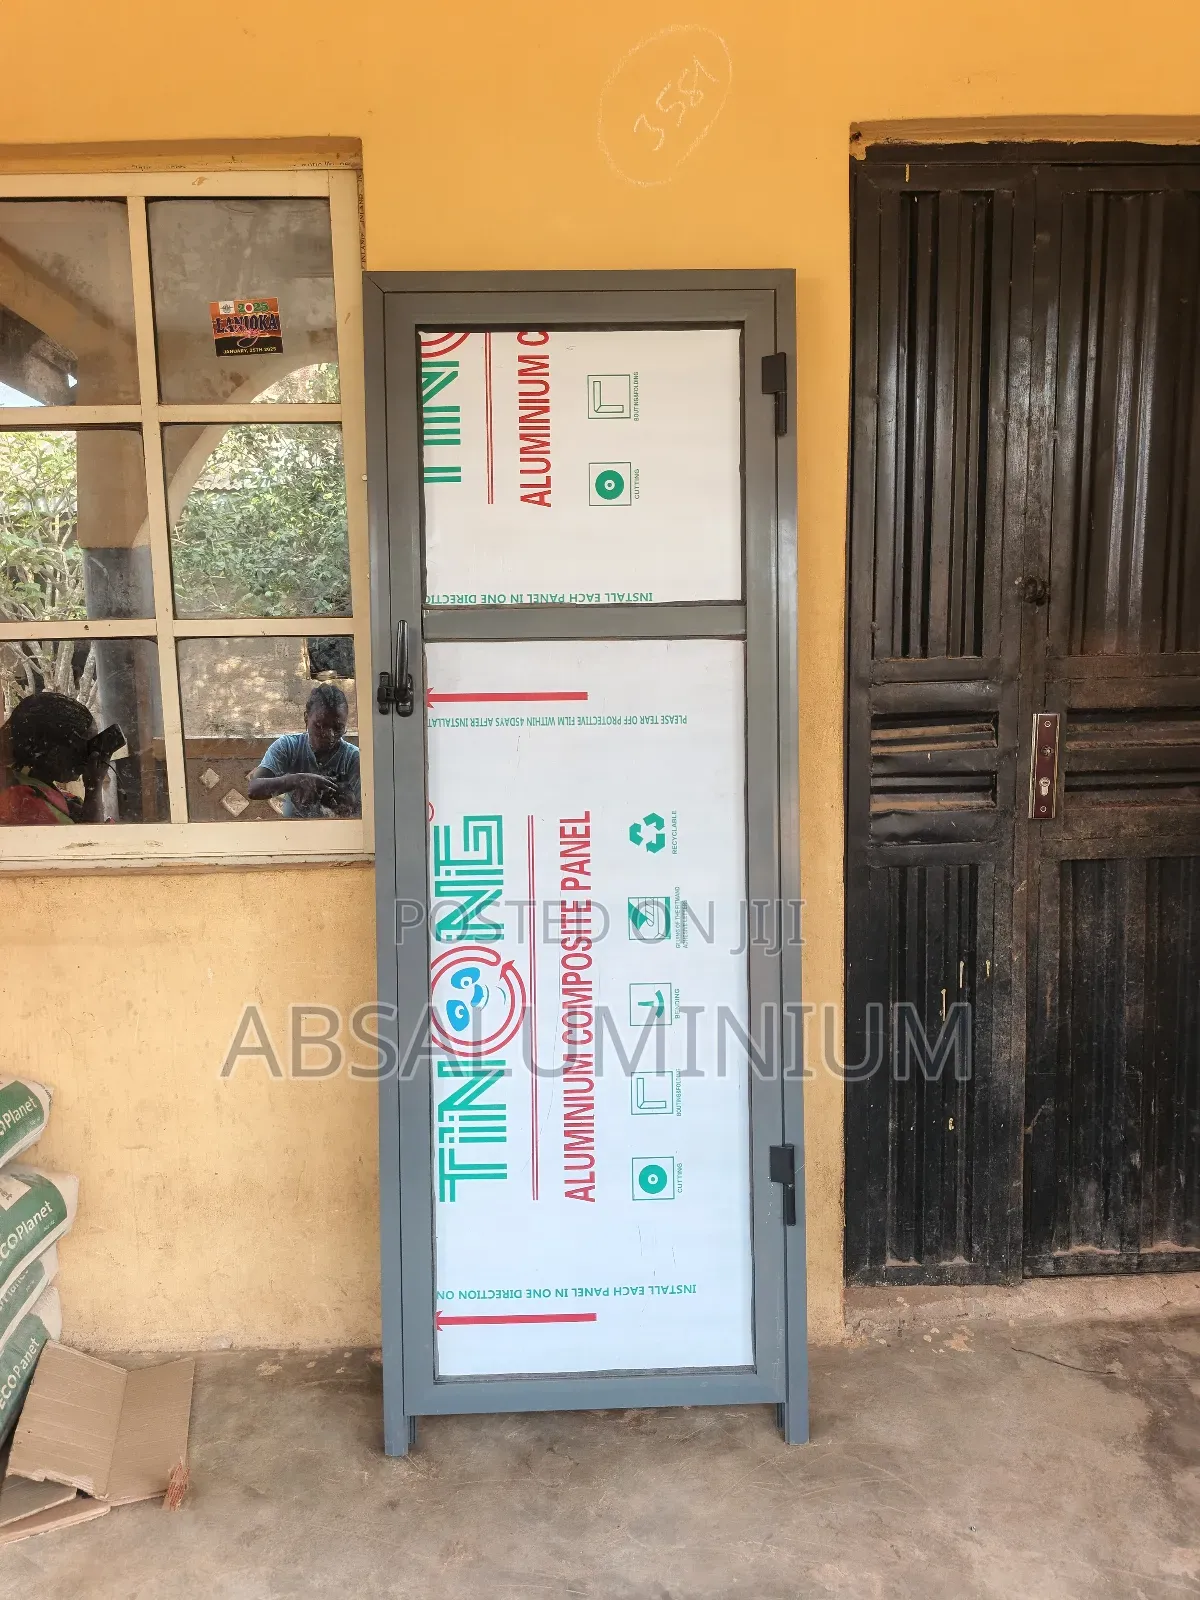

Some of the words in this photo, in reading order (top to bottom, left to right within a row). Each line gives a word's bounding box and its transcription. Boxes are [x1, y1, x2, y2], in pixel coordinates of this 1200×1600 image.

[237, 302, 270, 313] 2025
[518, 354, 551, 508] ALUMINIUM
[480, 594, 507, 604] ONE
[510, 594, 524, 603] IN
[527, 593, 565, 603] PANEL
[569, 593, 601, 602] EACH
[604, 592, 653, 602] INSTALL
[470, 716, 493, 727] AFTER
[498, 716, 525, 727] 45DAYS
[526, 716, 556, 727] WITHIN
[558, 716, 575, 726] FILM
[578, 715, 622, 726] PROTECTIVE
[623, 715, 638, 725] OFF
[640, 715, 660, 725] TEAR
[660, 714, 688, 725] PLEASE
[560, 810, 590, 891] PANEL
[561, 899, 592, 1045] COMPOSITE
[564, 1054, 595, 1203] ALUMINIUM
[458, 1288, 523, 1300] DIRECTION
[526, 1288, 552, 1299] ONE
[555, 1287, 569, 1297] IN
[571, 1287, 609, 1297] PANEL
[613, 1285, 645, 1296] EACH
[650, 1284, 697, 1295] INSTALL
